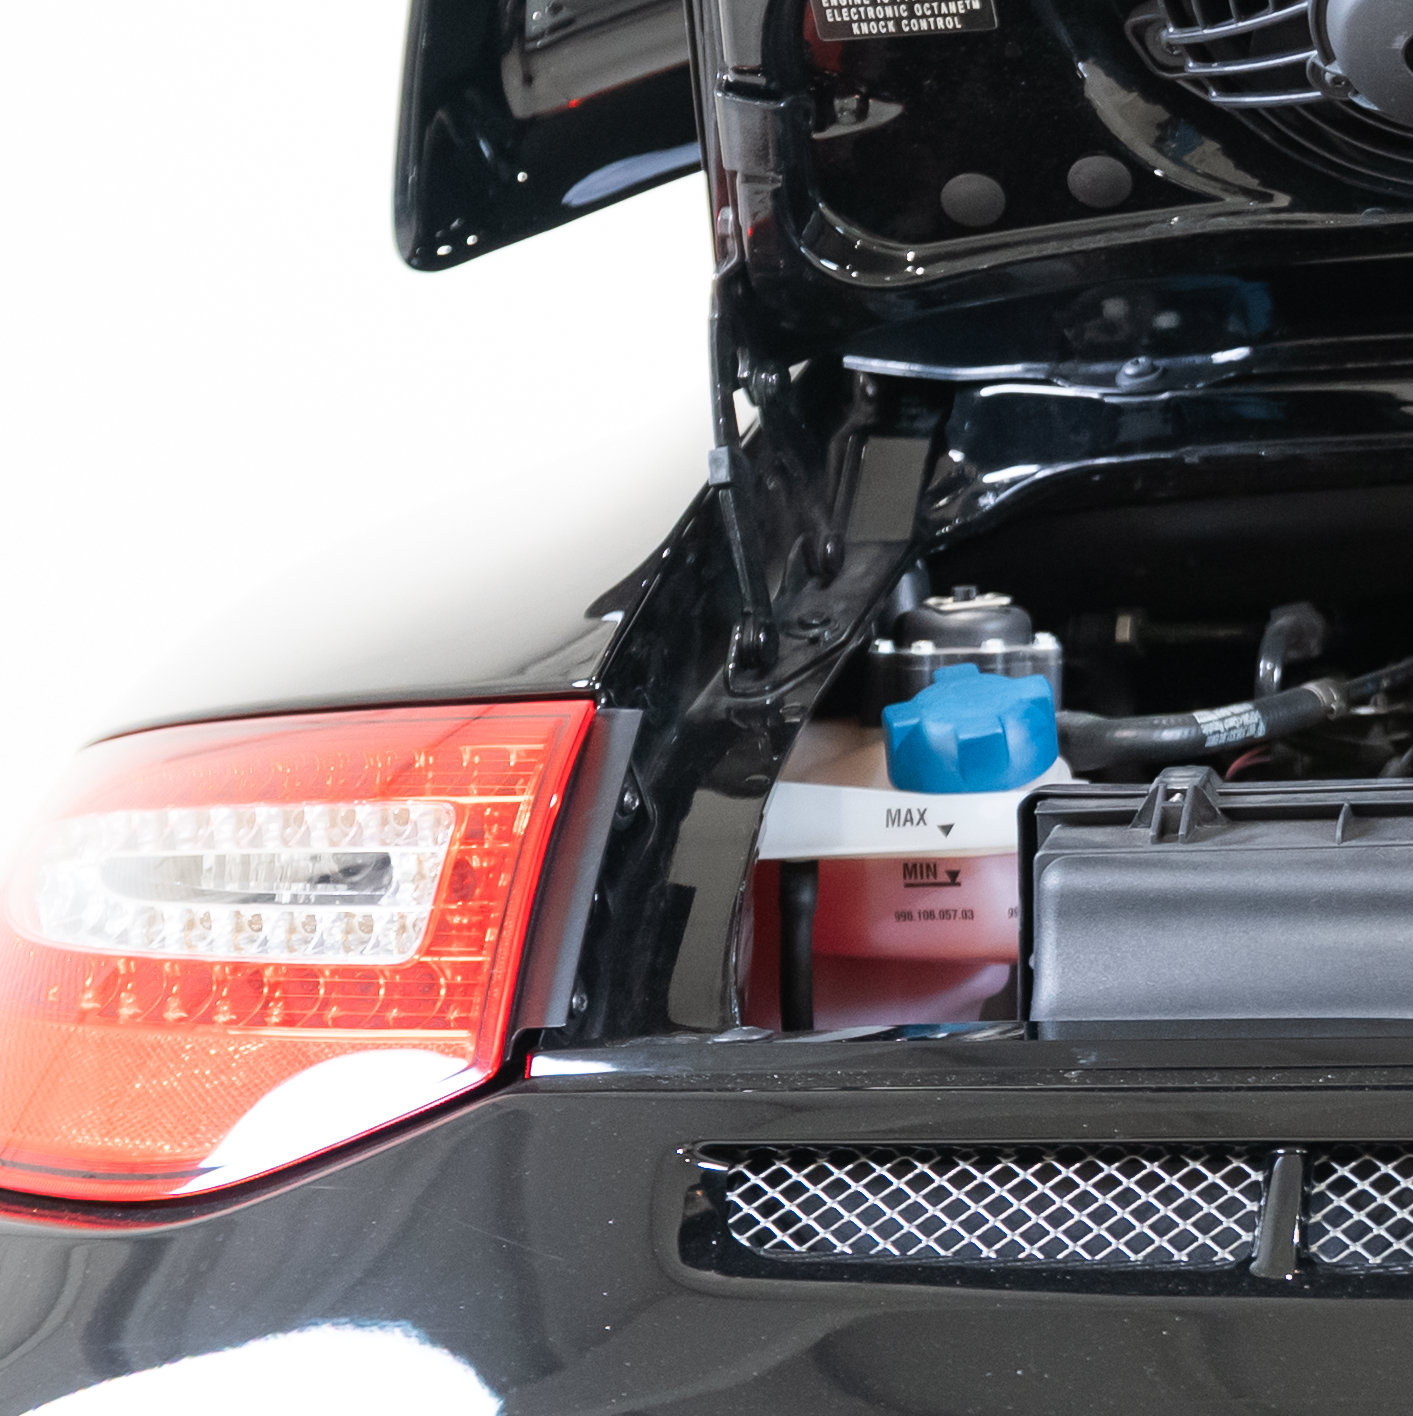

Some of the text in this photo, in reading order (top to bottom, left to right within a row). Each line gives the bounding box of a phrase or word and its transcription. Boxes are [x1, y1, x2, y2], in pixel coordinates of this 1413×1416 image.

[825, 4, 908, 22] ELECTRONIC
[852, 16, 962, 35] KNOCK CONTROL
[886, 808, 928, 829] MAX
[903, 862, 937, 880] MIN
